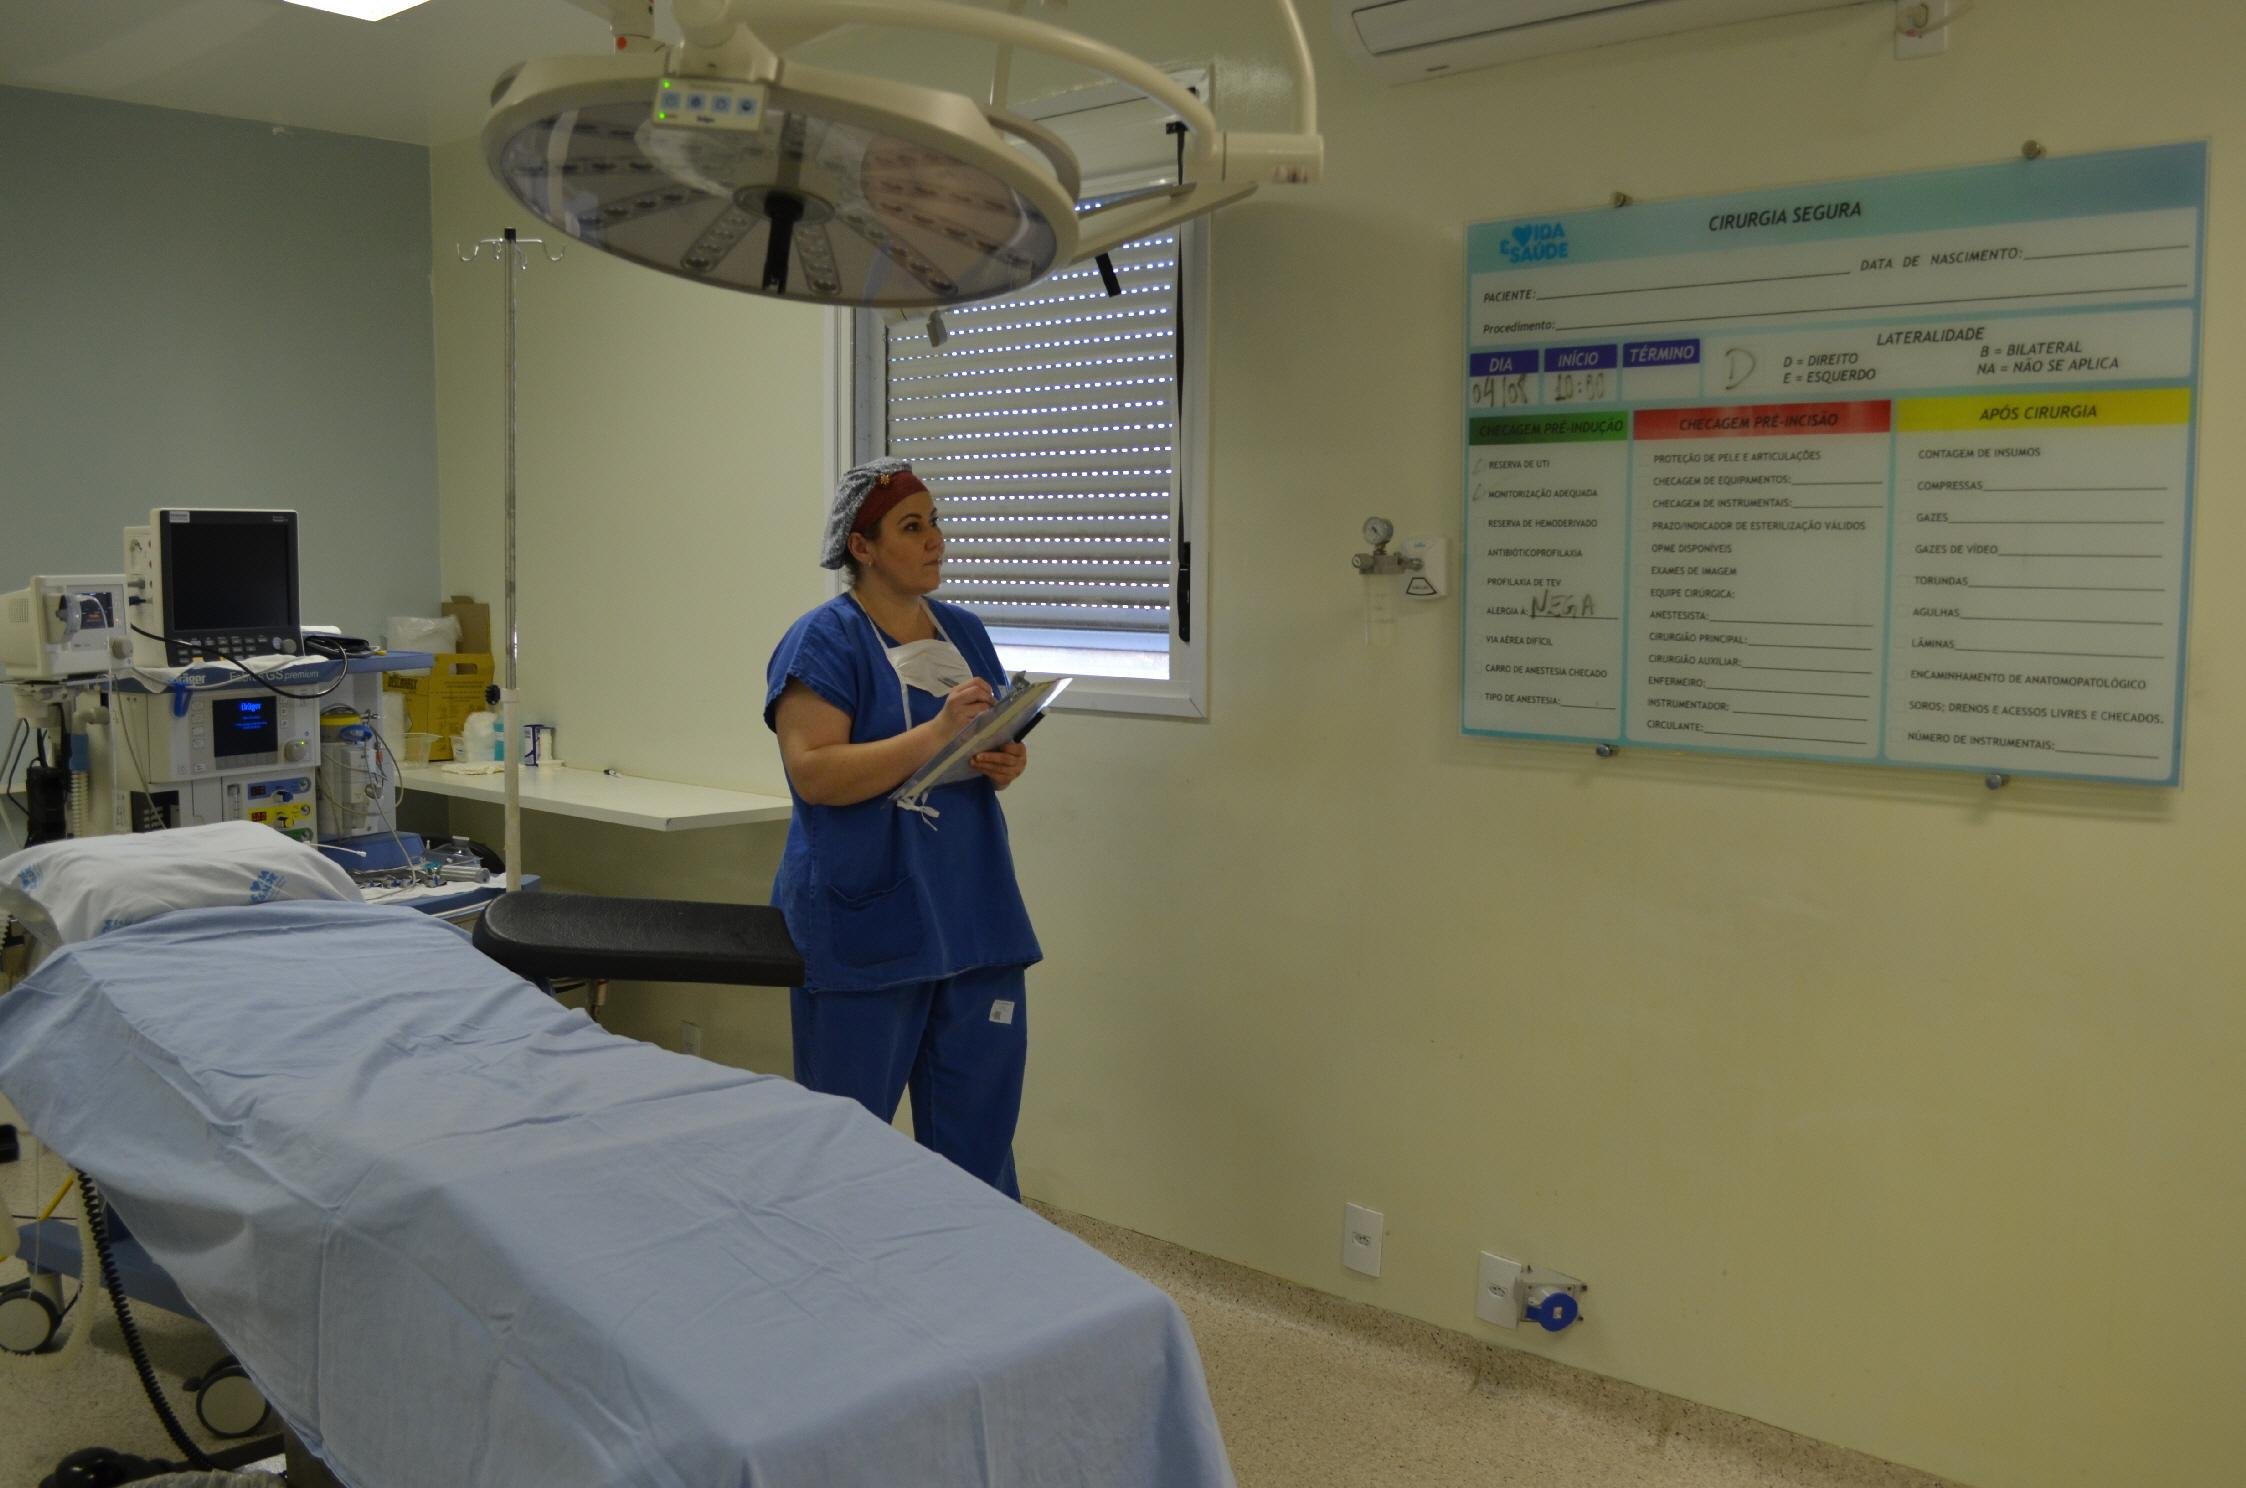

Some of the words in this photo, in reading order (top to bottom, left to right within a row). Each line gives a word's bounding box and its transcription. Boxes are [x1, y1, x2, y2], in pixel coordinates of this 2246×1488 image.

[1709, 209, 1786, 231] CIRURGIA
[1792, 202, 1862, 223] SEGURA
[1510, 242, 1568, 263] SAÚDE
[1483, 289, 1536, 303] PACIENTE:
[1860, 258, 1893, 271] DATA
[1902, 255, 1920, 267] DE
[1931, 247, 2022, 266] NASCIMENTO:
[1483, 320, 1555, 334] Procedimento:
[1876, 326, 1985, 346] LATERALIDADE
[1630, 346, 1694, 362] TÉRMINO
[1980, 345, 1990, 358] B
[2006, 341, 2083, 356] BILATERAL
[1489, 358, 1512, 372] DIA
[1558, 351, 1598, 367] INÍCIO
[1783, 356, 1792, 368] D
[1807, 352, 1859, 366] DIREITO
[1976, 362, 1995, 375] NA
[2013, 358, 2045, 373] NÃO
[2050, 359, 2064, 371] SE
[2068, 356, 2119, 370] APLICA
[1783, 372, 1792, 384] E
[1807, 368, 1876, 384] ESQUERDO
[1979, 404, 2018, 421] APÓS
[2023, 403, 2098, 420] CIRURGIA
[1479, 421, 1541, 437] CHECAGEM
[1544, 419, 1624, 436] PRÉ-INDUÇÃO
[1679, 416, 1749, 431] CHECAGEM
[1753, 413, 1839, 428] PRÉ-INCISÃO
[1653, 452, 1700, 464] PROTEÇÃO
[1703, 454, 1715, 463] DE
[1718, 453, 1740, 462] PELE
[1742, 453, 1749, 462] E
[1751, 450, 1821, 463] ARTICULAÇÕES
[1918, 449, 1975, 460] CONTAGEM
[1977, 448, 1991, 458] DE
[1994, 447, 2041, 457] INSUMOS
[1488, 460, 1522, 470] RESERVA
[1524, 460, 1535, 469] DE
[1536, 459, 1550, 469] UTI
[1653, 476, 1701, 486] CHECAGEM
[1703, 476, 1715, 485] DE
[1718, 475, 1792, 486] EQUIPAMENTOS:
[1917, 481, 1983, 491] COMPRESSAS
[1488, 487, 1551, 499] MONITORIZAÇÃO
[1553, 488, 1598, 499] ADEQUADA
[1652, 499, 1701, 509] CHECAGEM
[1703, 499, 1715, 508] DE
[1717, 498, 1793, 508] INSTRUMENTAIS:
[1488, 519, 1521, 528] RESERVA
[1522, 519, 1533, 528] DE
[1535, 519, 1598, 528] HEMODERIVADO
[1916, 512, 1948, 523] GAZES
[1735, 521, 1748, 531] DE
[1750, 521, 1823, 533] ESTERILIZAÇÃO
[1826, 520, 1866, 531] VÁLIDOS
[1651, 544, 1676, 554] OPME
[1678, 543, 1732, 554] DISPONÍVEIS
[1914, 544, 1948, 554] GAZES
[1950, 544, 1964, 554] DE
[1967, 542, 1999, 554] VÍDEO
[1651, 567, 1685, 576] EXAMES
[1688, 567, 1699, 576] DE
[1701, 567, 1738, 576] IMAGEM
[1487, 577, 1532, 586] PROFILAXIA
[1533, 578, 1544, 587] DE
[1914, 576, 1968, 586] TORUNDAS
[1650, 589, 1682, 599] EQUIPE
[1486, 606, 1519, 616] ALERGIA
[1650, 611, 1710, 621] ANESTESISTA:
[1912, 607, 1960, 618] AGULHAS
[1486, 635, 1499, 644] VIA
[1499, 634, 1525, 645] AÉREA
[1649, 631, 1696, 642] CIRURGIÃO
[1912, 637, 1955, 649] LÂMINAS
[1648, 653, 1696, 665] CIRURGIÃO
[284, 670, 319, 681] premium
[1485, 664, 1511, 673] CARRO
[1513, 665, 1524, 674] DE
[1525, 666, 1567, 676] ANESTESIA
[1568, 667, 1608, 678] CHECADO
[1648, 676, 1706, 688] ENFERMEIRO:
[1910, 669, 2006, 683] ENCAMINHAMENTO
[2009, 674, 2022, 684] DE
[2024, 674, 2146, 690] ANATOMOPATOLÓGICO
[1485, 692, 1503, 702] TIPO
[1504, 694, 1515, 702] DE
[1516, 694, 1561, 705] ANESTESIA:
[1647, 699, 1729, 711] INSTRUMENTADOR:
[1948, 702, 1989, 714] DRENOS
[1992, 705, 1999, 715] E
[2002, 706, 2047, 718] ACESSOS
[2051, 708, 2088, 720] LIVRES
[2091, 710, 2098, 720] E
[2101, 711, 2164, 724] CHECADOS.
[1646, 720, 1704, 732] CIRCULANTE:
[1907, 731, 1950, 744] NÚMERO
[1953, 734, 1967, 745] DE
[1970, 735, 2055, 750] INSTRUMENTAIS:
